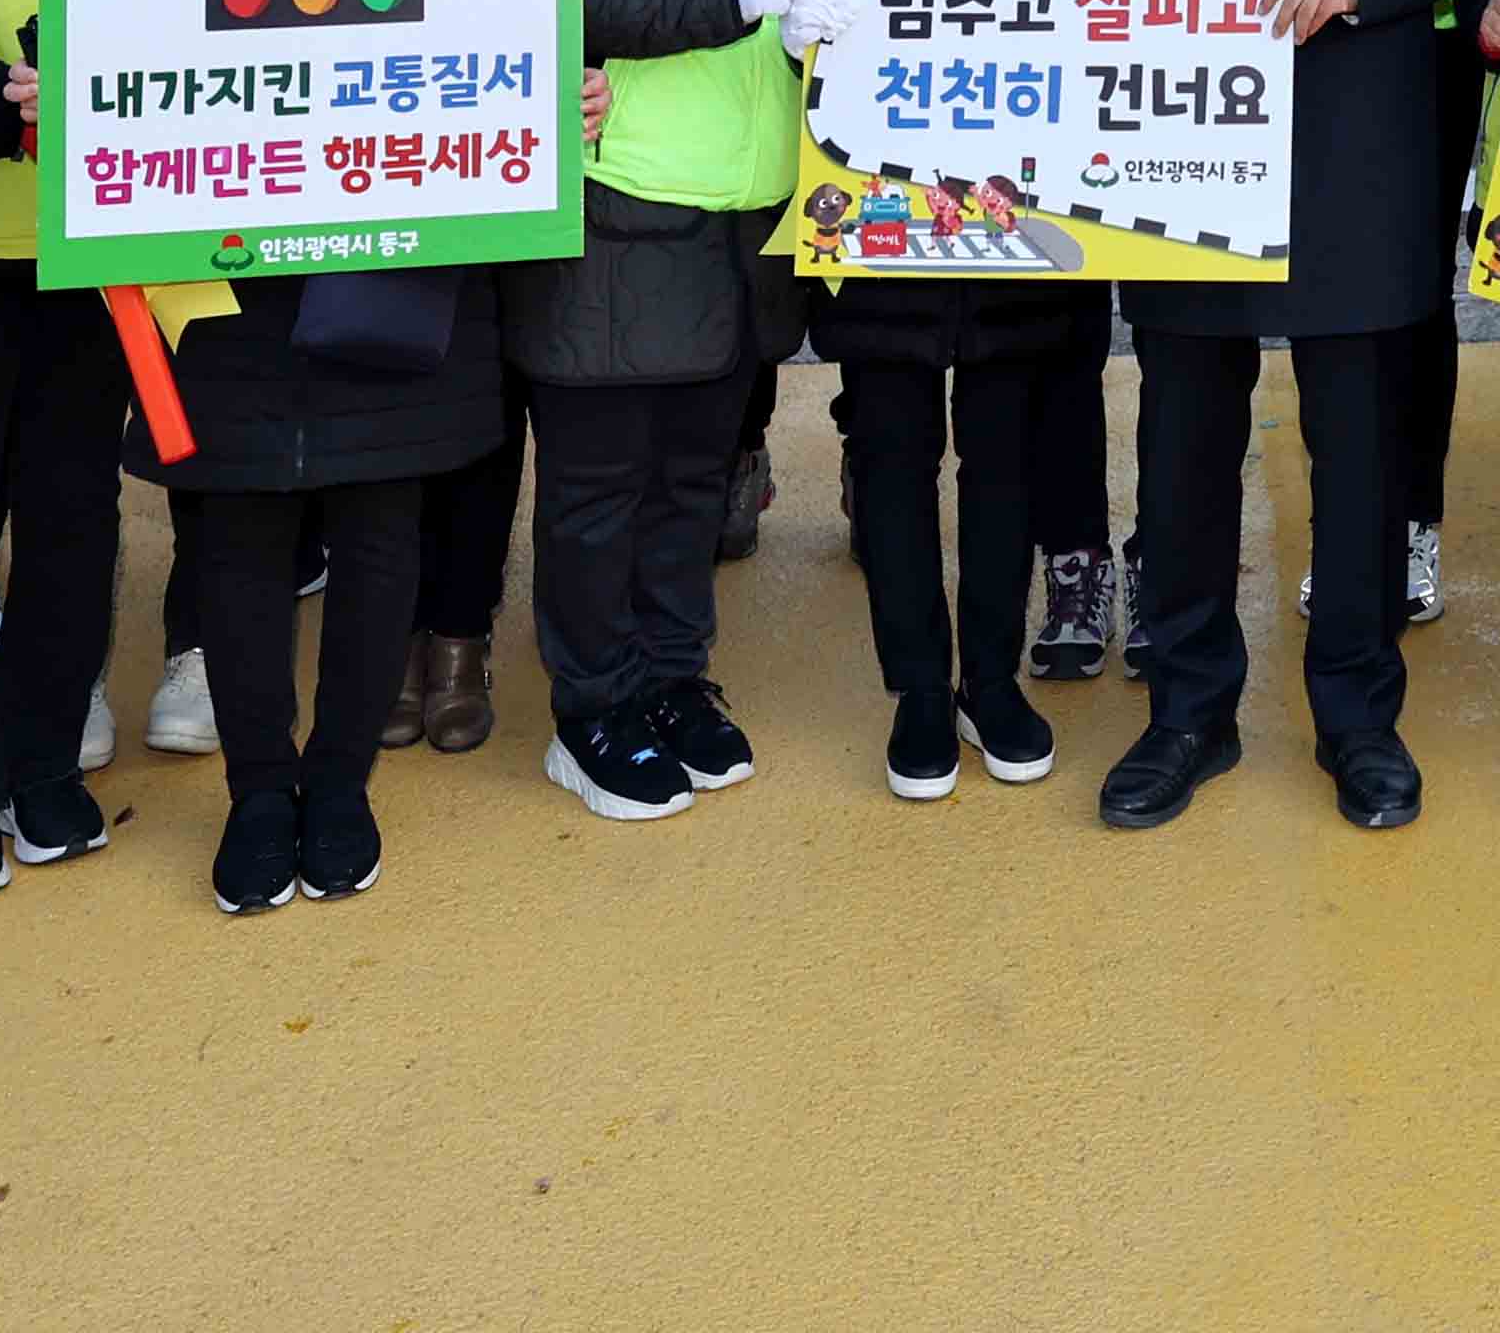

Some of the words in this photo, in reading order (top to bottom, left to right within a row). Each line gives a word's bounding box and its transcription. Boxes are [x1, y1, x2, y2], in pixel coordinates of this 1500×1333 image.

[91, 61, 311, 118] 내가지킨
[330, 52, 533, 113] 교통질서
[875, 58, 1063, 130] 천천히
[1085, 64, 1270, 132] 건너요
[85, 139, 308, 206] 함께만든
[323, 127, 539, 194] 행복세상
[1124, 160, 1225, 183] 인천광역시
[1232, 160, 1268, 183] 동구
[259, 234, 372, 263] 인천광역시
[378, 231, 419, 257] 동구
